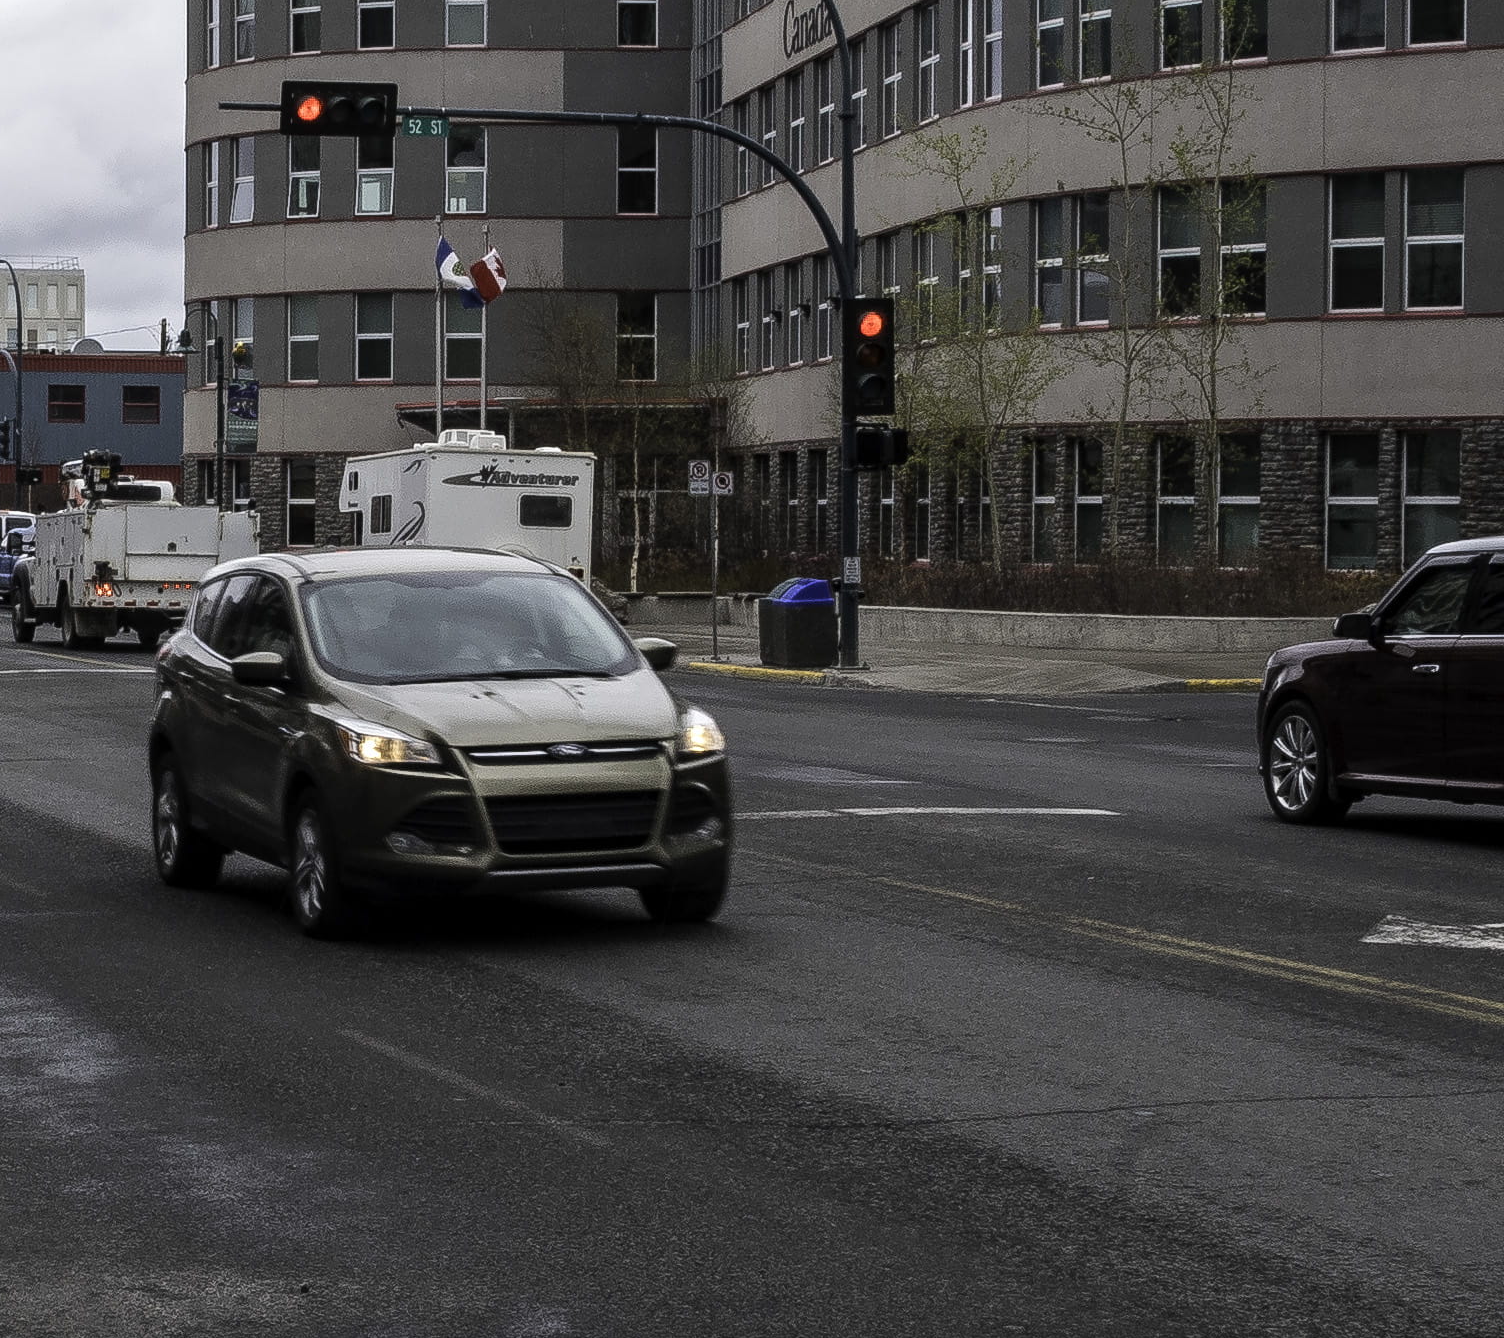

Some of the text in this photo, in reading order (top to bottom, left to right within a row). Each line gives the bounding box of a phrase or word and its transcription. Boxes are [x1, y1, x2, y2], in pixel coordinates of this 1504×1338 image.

[408, 119, 443, 135] 52 ST
[489, 471, 580, 486] Adventurer
